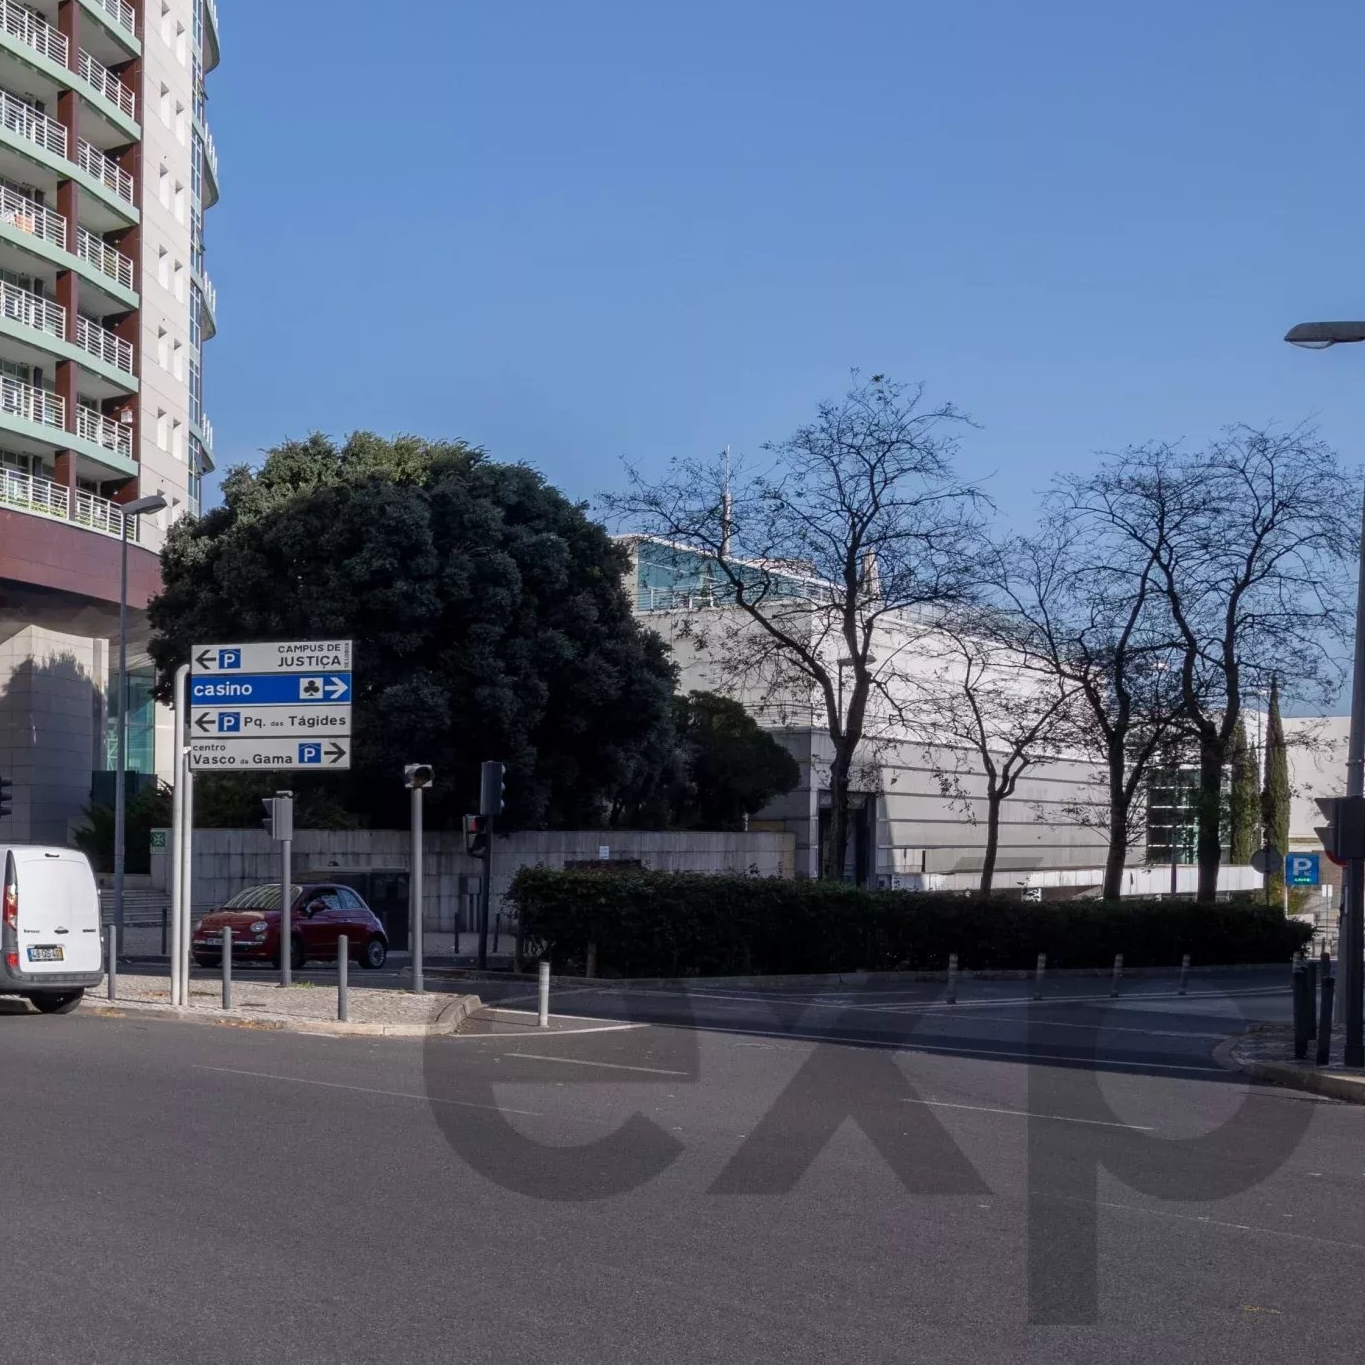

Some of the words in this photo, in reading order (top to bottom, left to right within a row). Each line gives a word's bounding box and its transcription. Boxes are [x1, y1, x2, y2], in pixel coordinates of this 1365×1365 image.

[278, 644, 324, 654] CAMPUS
[327, 643, 341, 652] DE
[224, 653, 236, 668] P
[278, 655, 342, 669] JUSTIÇA
[194, 682, 253, 696] casino
[223, 716, 235, 731] P
[244, 717, 266, 731] Pq.
[288, 715, 346, 729] Tágides
[193, 744, 226, 752] centro
[193, 754, 236, 765] Vasco
[252, 753, 293, 765] Gama
[304, 748, 316, 763] P
[1293, 857, 1312, 876] P
